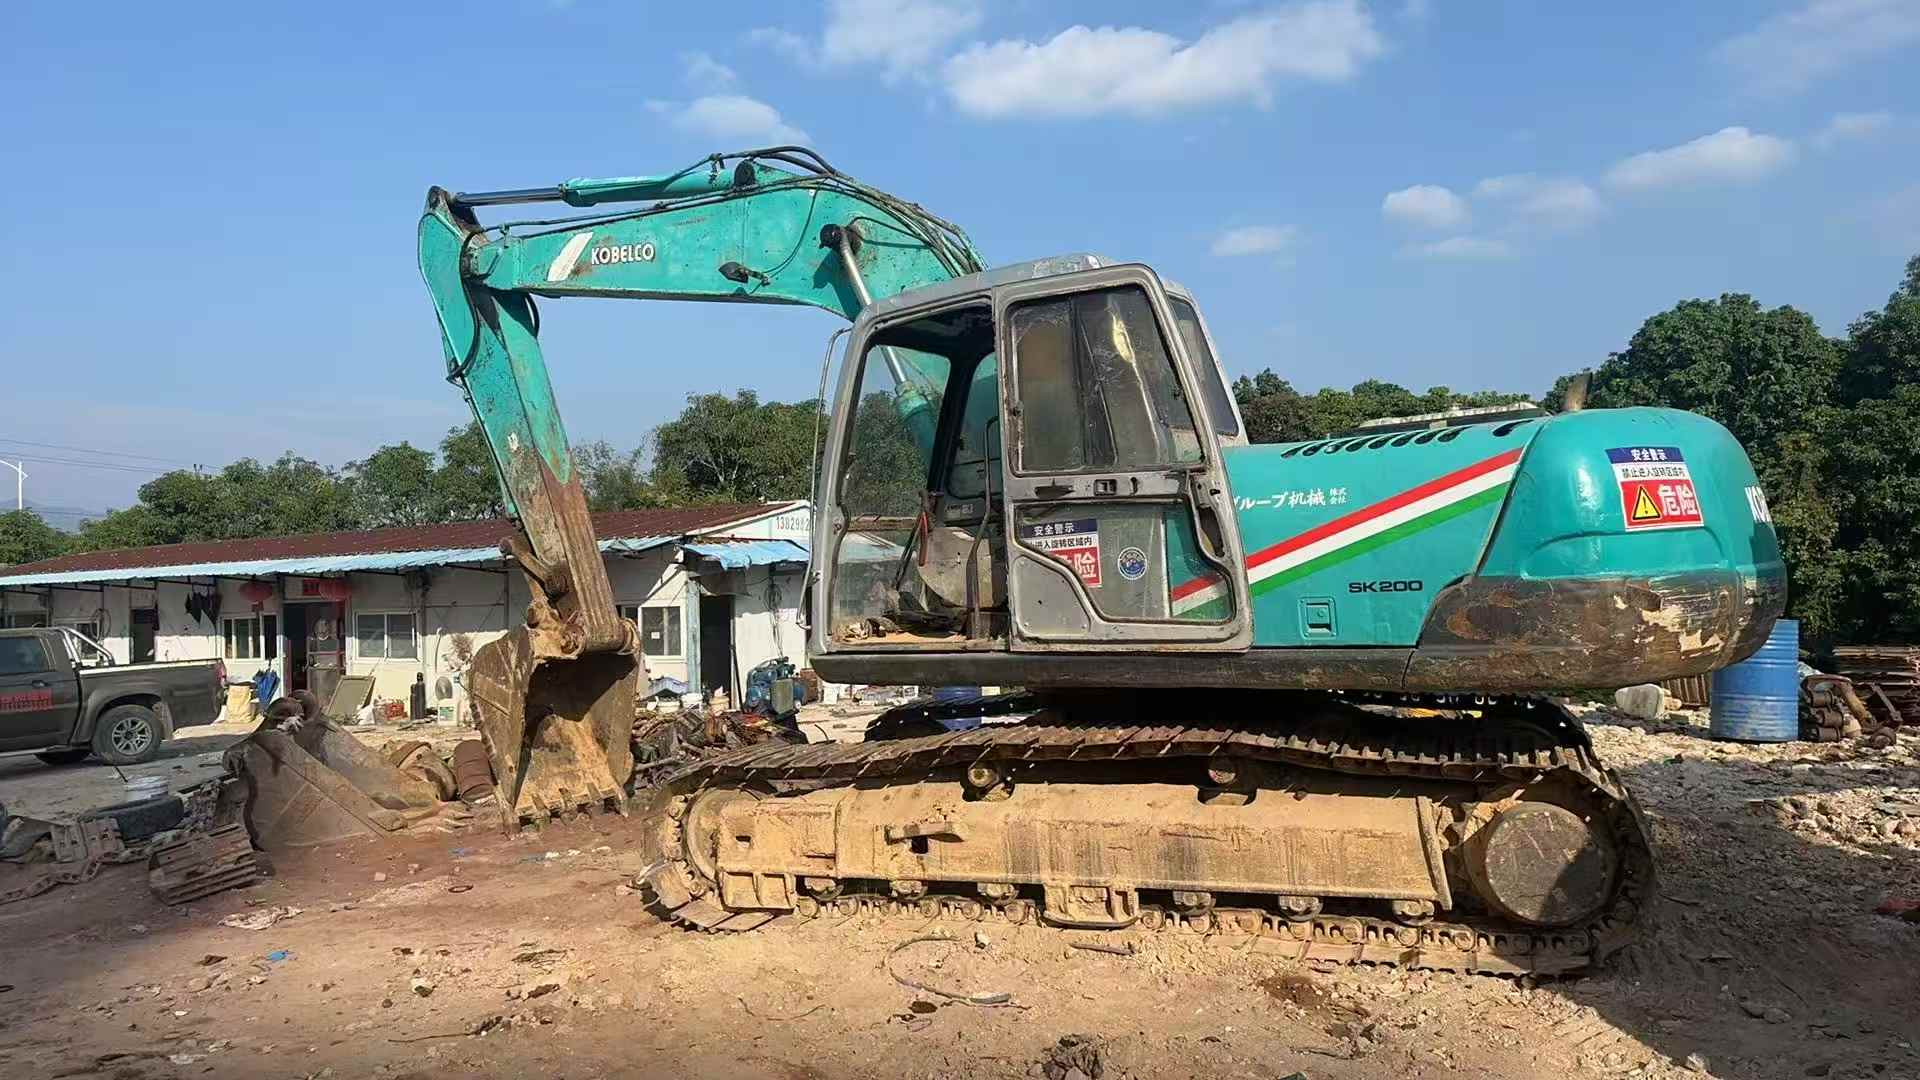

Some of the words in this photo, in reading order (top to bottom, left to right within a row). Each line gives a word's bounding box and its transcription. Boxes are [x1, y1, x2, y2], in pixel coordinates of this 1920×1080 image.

[591, 243, 655, 265] KOBELCO
[1631, 448, 1667, 461] 安全警示
[1657, 484, 1698, 516] 危险
[1034, 523, 1074, 536] 安全警示
[1349, 580, 1423, 593] SK200
